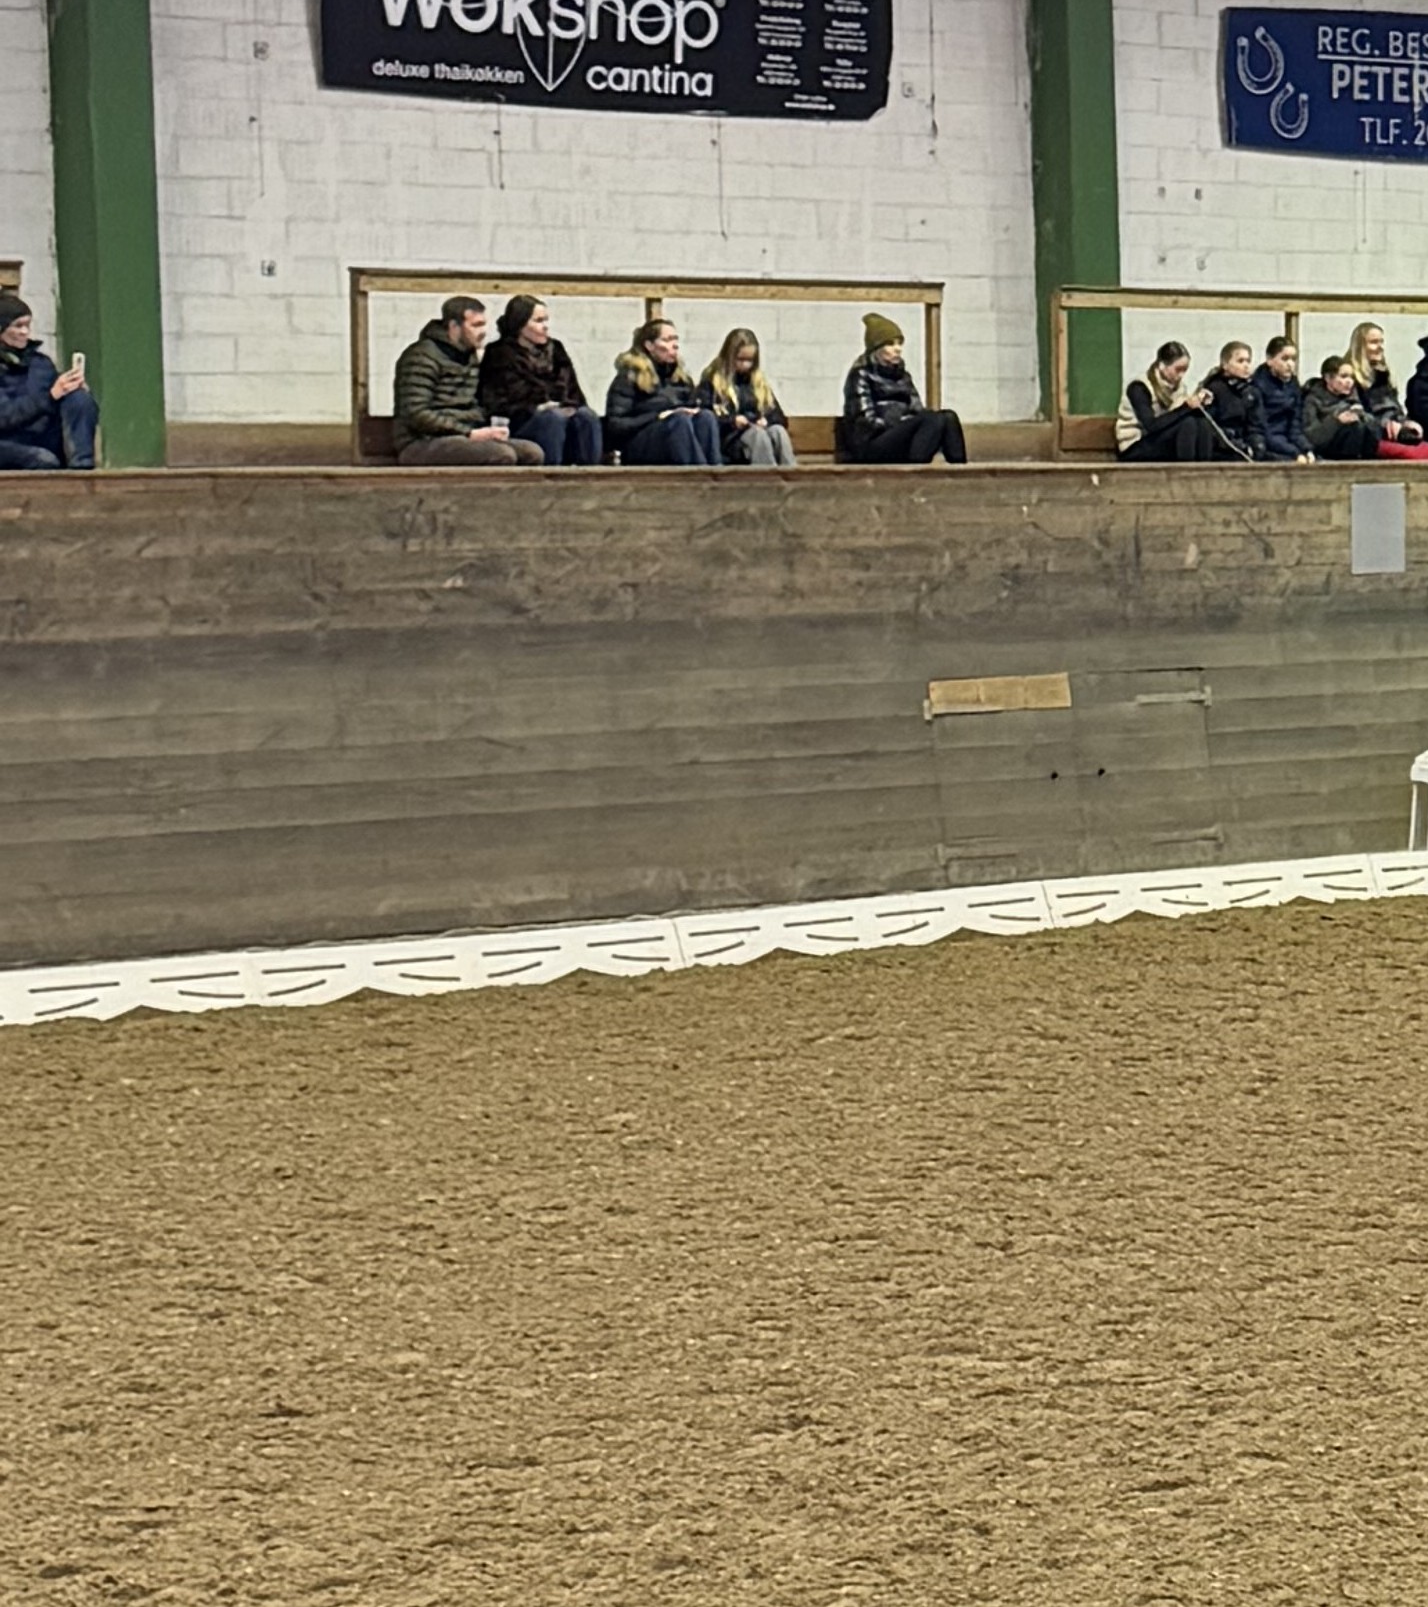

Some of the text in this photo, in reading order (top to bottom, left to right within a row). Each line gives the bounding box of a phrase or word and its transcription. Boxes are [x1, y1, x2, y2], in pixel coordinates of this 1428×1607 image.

[1316, 25, 1379, 58] REG.
[372, 58, 431, 80] deluxe
[585, 61, 715, 98] cantina
[1360, 117, 1408, 147] TLF.
